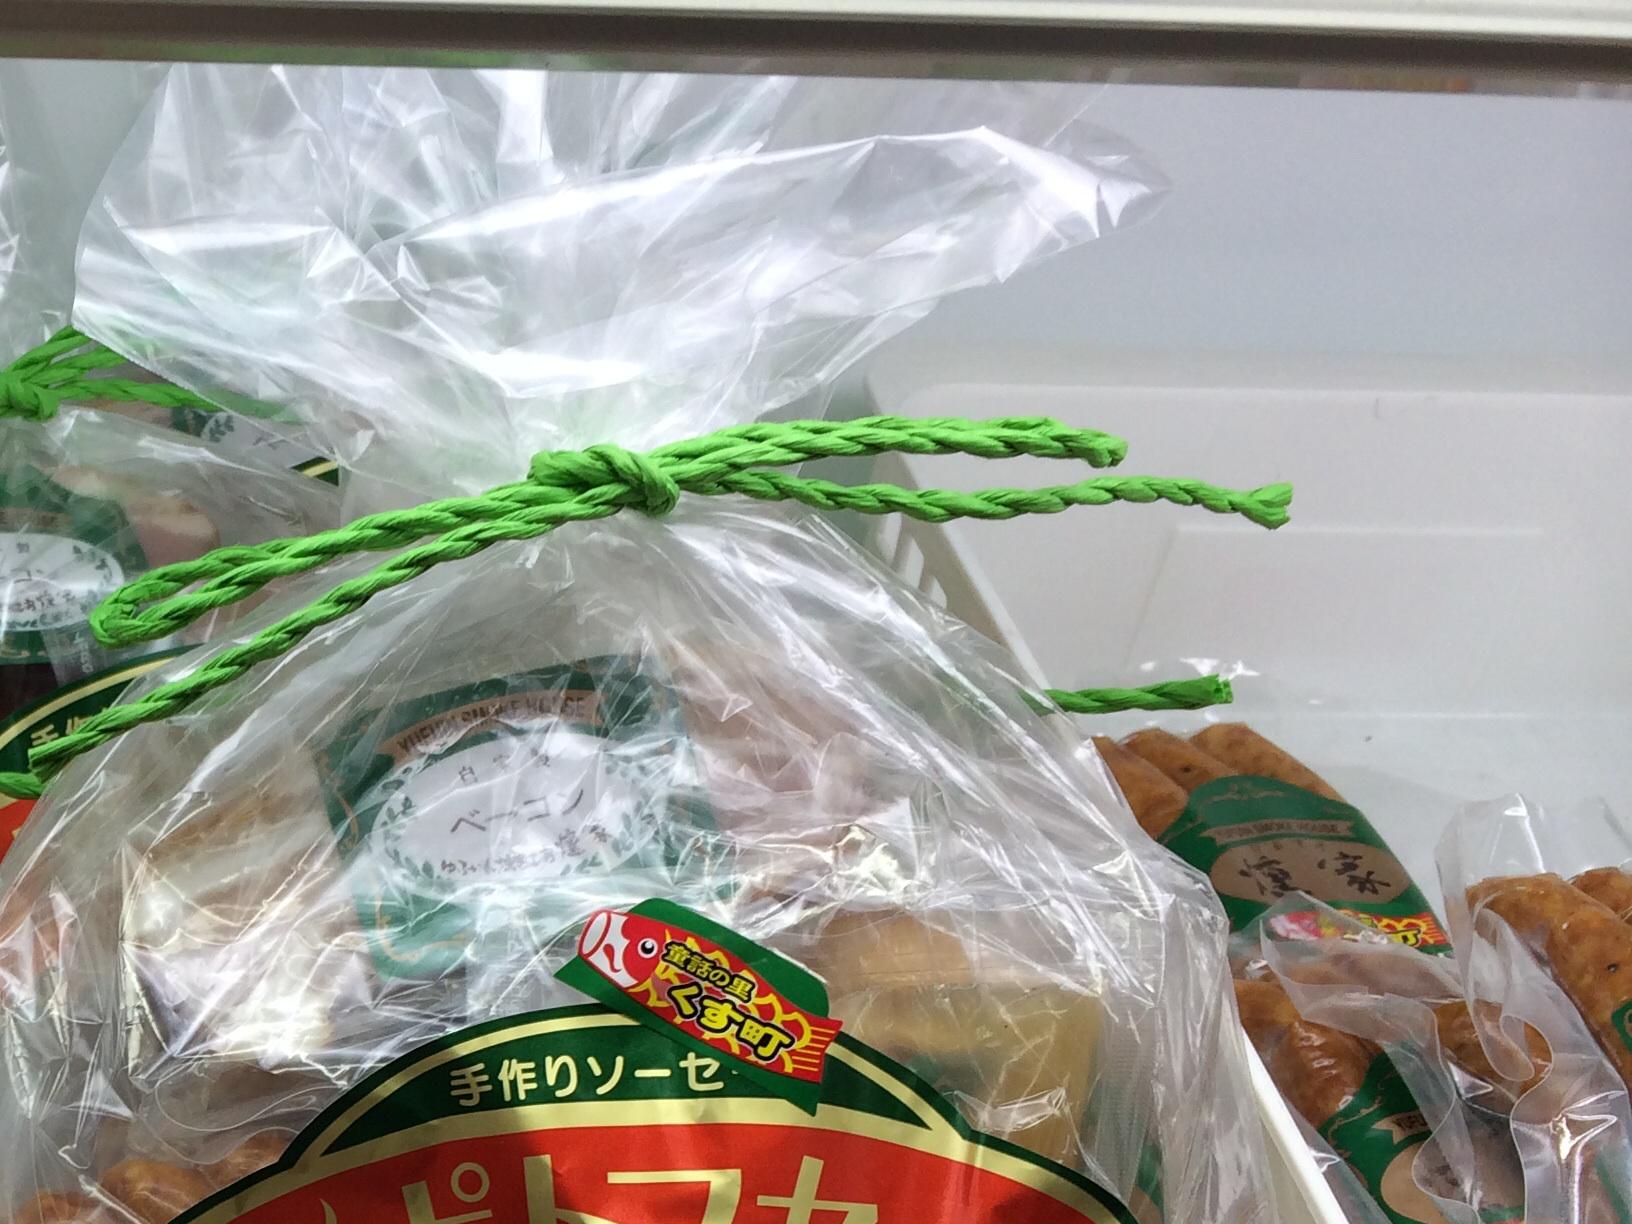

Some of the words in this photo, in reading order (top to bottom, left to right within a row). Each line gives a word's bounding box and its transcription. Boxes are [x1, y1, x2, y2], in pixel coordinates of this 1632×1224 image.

[662, 941, 756, 1004] 童話の里
[667, 982, 797, 1063] くす町
[449, 1051, 730, 1109] 手作りソーセ
